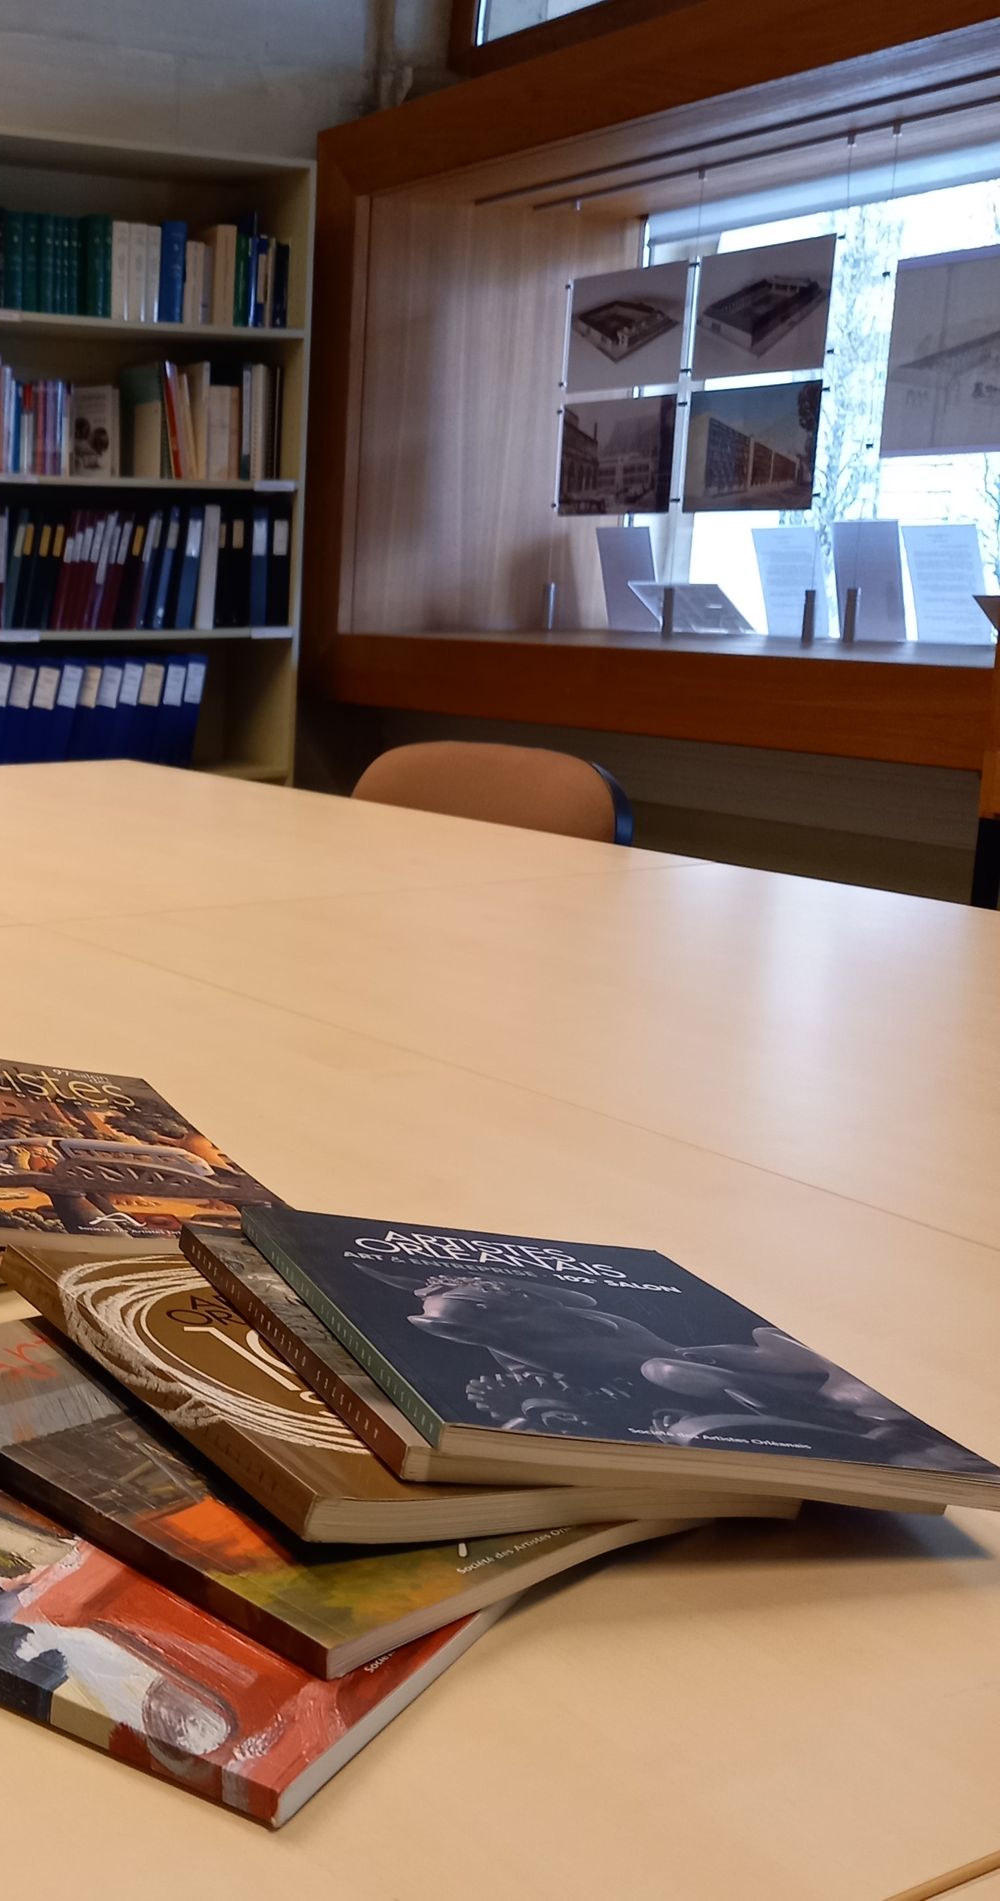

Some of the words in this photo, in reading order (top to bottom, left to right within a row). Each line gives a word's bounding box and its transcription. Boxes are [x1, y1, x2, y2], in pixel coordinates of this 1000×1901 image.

[385, 1230, 577, 1262] ARTISTES
[343, 1250, 385, 1261] ART
[391, 1255, 405, 1264] &
[411, 1257, 538, 1279] ENTREPRISE
[603, 1278, 683, 1295] SALON
[628, 1427, 674, 1437] Société
[702, 1434, 750, 1444] Artistes
[456, 1557, 494, 1575] Société
[495, 1550, 514, 1560] des
[514, 1534, 551, 1552] Artistes
